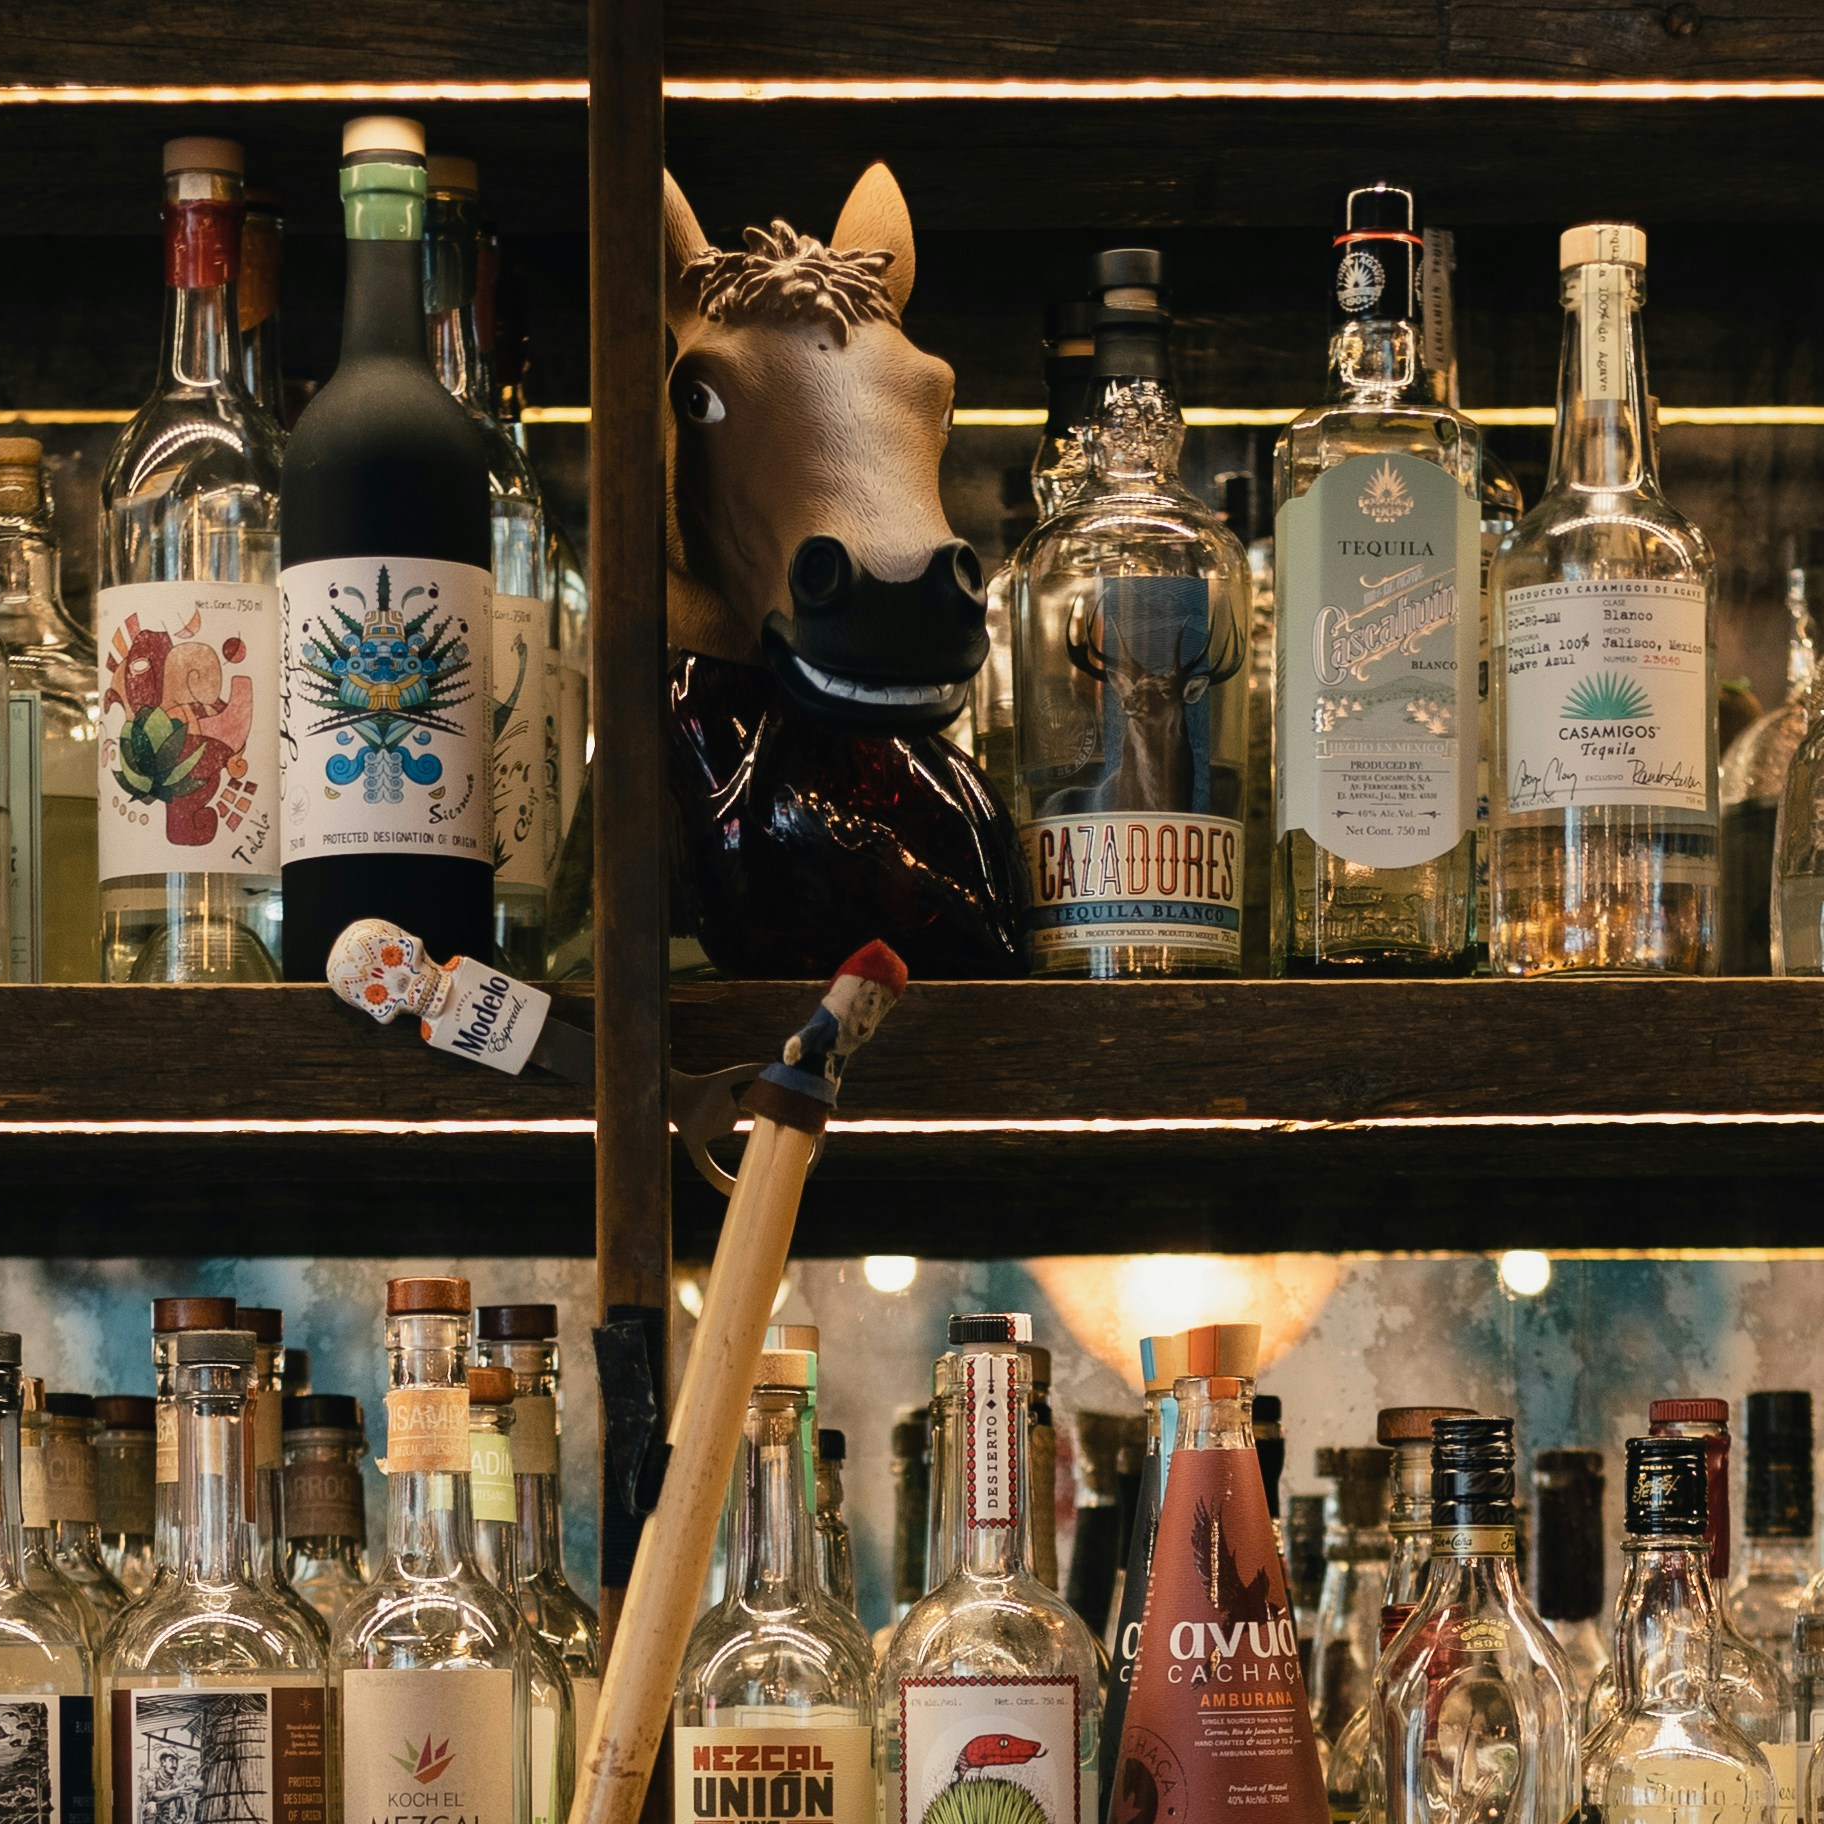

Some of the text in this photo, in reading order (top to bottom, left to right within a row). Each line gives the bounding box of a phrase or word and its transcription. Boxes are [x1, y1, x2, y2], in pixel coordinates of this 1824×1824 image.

[1338, 540, 1435, 558] TEQUILA
[1509, 584, 1701, 602] PRODUCTOS CASAMIGOS DE AGAVE
[1603, 610, 1653, 621] Blanco
[1314, 579, 1458, 687] Cascahuín
[1508, 633, 1702, 660] Tequila 100% Jalisco, Mexico
[1411, 660, 1457, 671] BLANCO
[1508, 654, 1576, 674] Agave Azul
[1558, 724, 1656, 741] CASAMIGOS
[1580, 741, 1636, 757] Tequila
[1350, 761, 1424, 771] PRODUCED BY:
[322, 832, 369, 846] PROTECTED
[373, 832, 434, 846] DESIGNATION
[437, 833, 449, 846] OF
[1346, 825, 1430, 836] Net Cont. 750 ml
[1039, 824, 1235, 902] CAZADORES
[1055, 903, 1224, 923] TEQUILA BLANCO
[451, 976, 510, 1056] Modelo
[487, 996, 528, 1053] Especial
[985, 1414, 1000, 1509] DESIERTO
[1170, 1606, 1297, 1660] avuá
[1201, 1692, 1293, 1707] AMBURANA
[693, 1745, 834, 1771] MEZCAL
[388, 1791, 464, 1808] KOCH EL
[693, 1770, 834, 1817] UNIÓN
